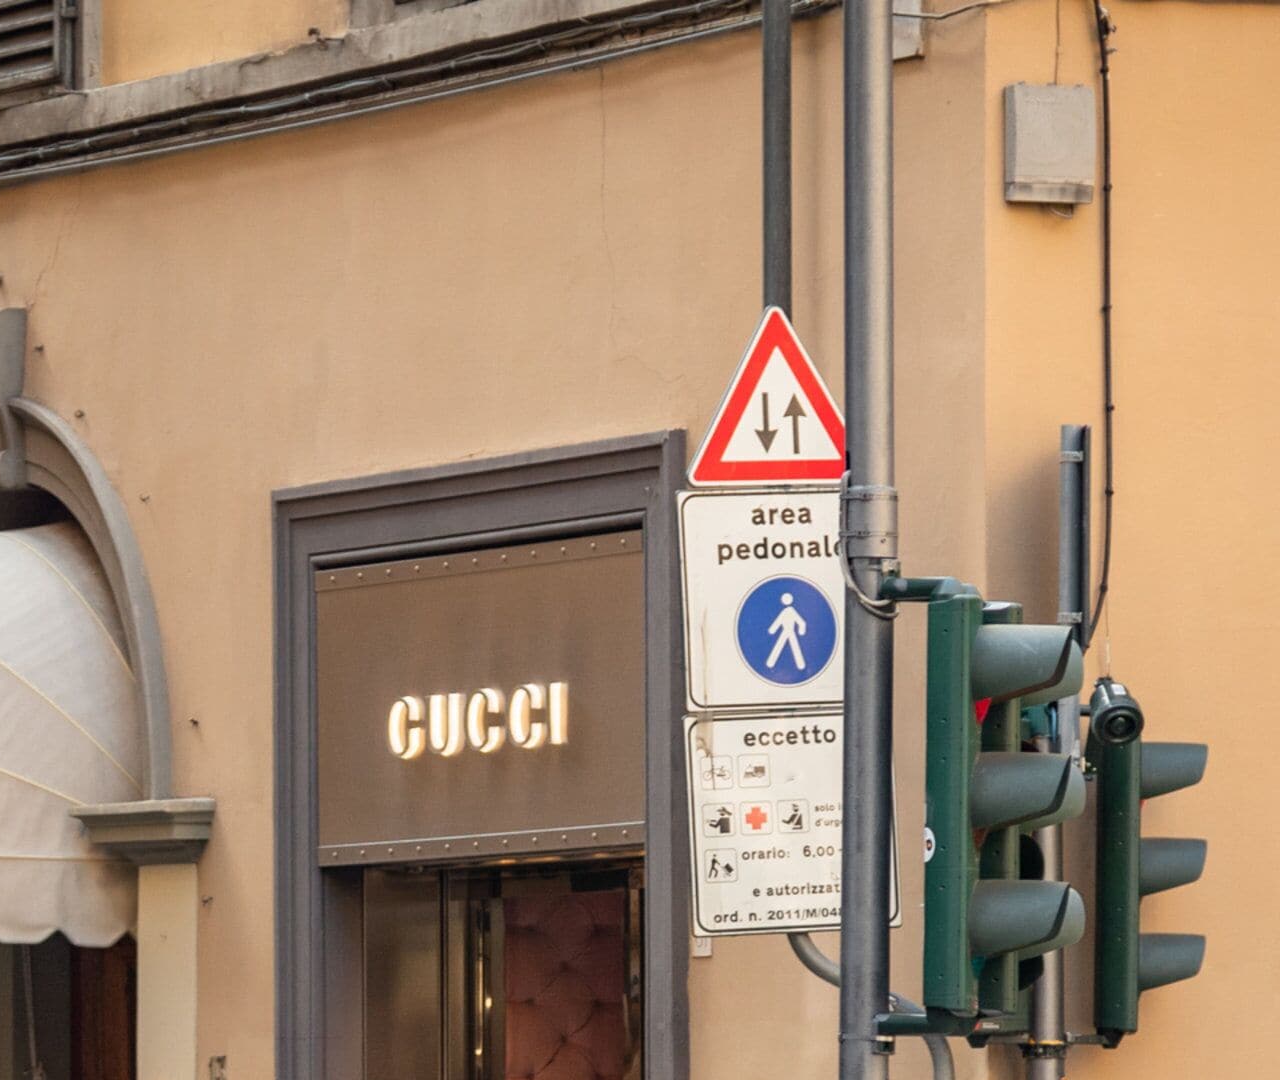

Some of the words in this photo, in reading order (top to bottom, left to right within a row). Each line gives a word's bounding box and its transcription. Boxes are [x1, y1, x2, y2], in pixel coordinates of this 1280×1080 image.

[751, 506, 812, 525] area
[388, 681, 569, 760] GUCCI
[743, 724, 837, 747] eccetto
[814, 802, 835, 812] solo
[814, 818, 842, 828] d'urg
[741, 846, 790, 861] orario:
[752, 887, 761, 897] e
[713, 911, 743, 924] ord.
[748, 912, 762, 922] n.
